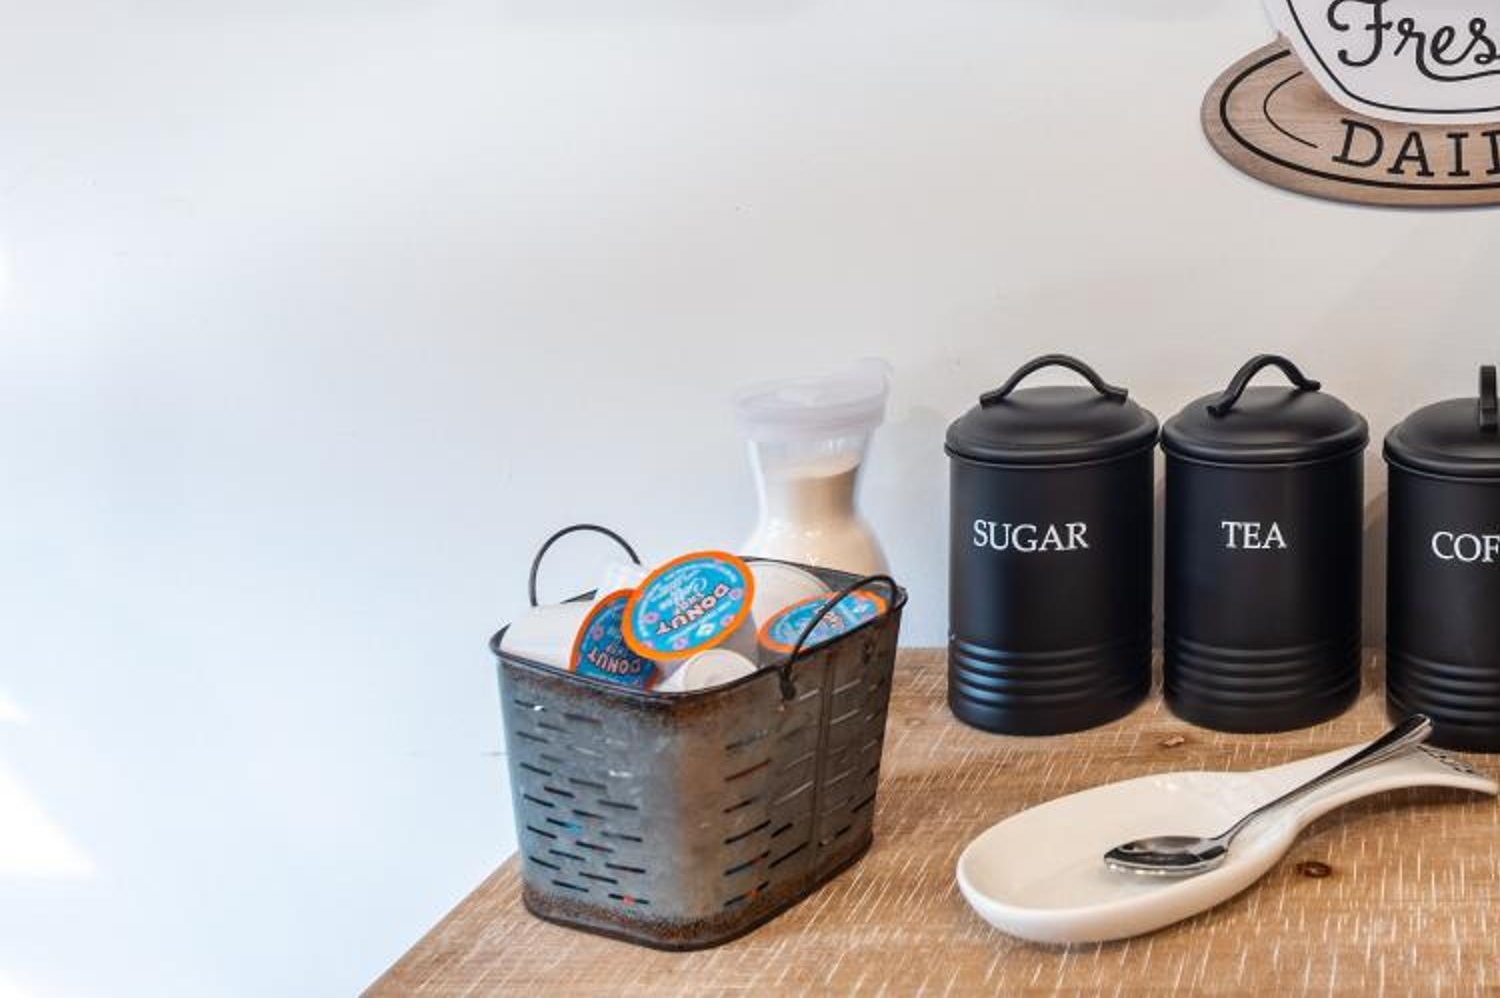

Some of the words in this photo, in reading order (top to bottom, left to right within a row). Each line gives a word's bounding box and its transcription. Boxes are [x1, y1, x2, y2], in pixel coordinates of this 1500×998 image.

[973, 518, 1089, 552] SUGAR
[1221, 521, 1287, 549] TEA
[655, 582, 731, 636] DONUT
[587, 647, 642, 675] DONUT
